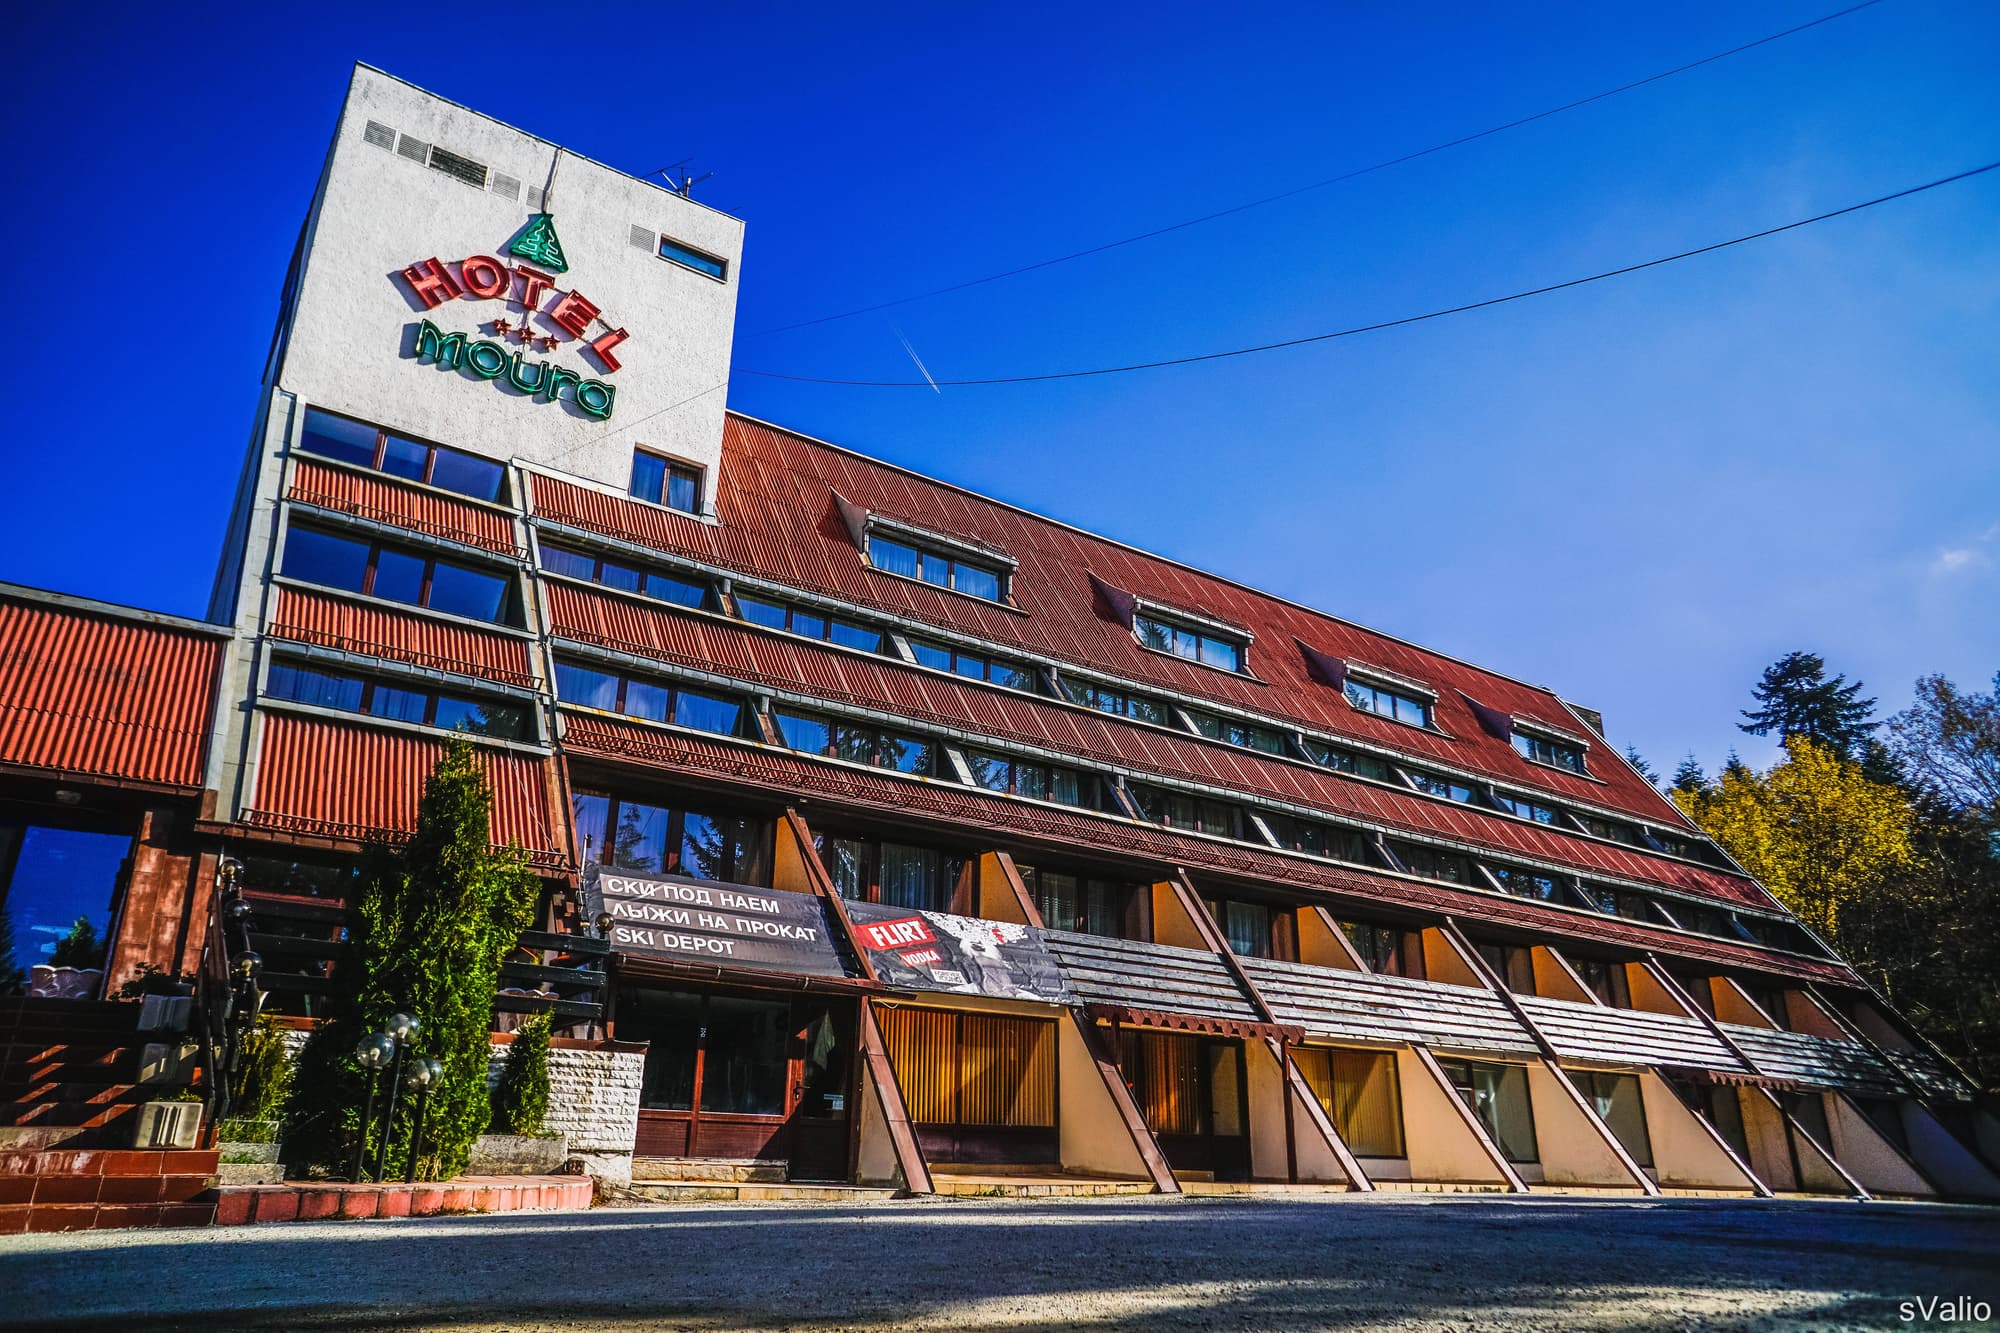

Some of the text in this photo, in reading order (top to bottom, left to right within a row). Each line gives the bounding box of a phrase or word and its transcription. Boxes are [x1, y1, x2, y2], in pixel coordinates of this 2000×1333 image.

[402, 255, 630, 373] HOTEL
[607, 878, 780, 914] СКИ ПОД НАЕМ
[612, 902, 817, 942] ЛЫЖИ НА ПРОКАТ
[868, 920, 928, 947] FLIRT
[615, 927, 735, 955] SKI DEPOT
[902, 949, 941, 966] VODKA
